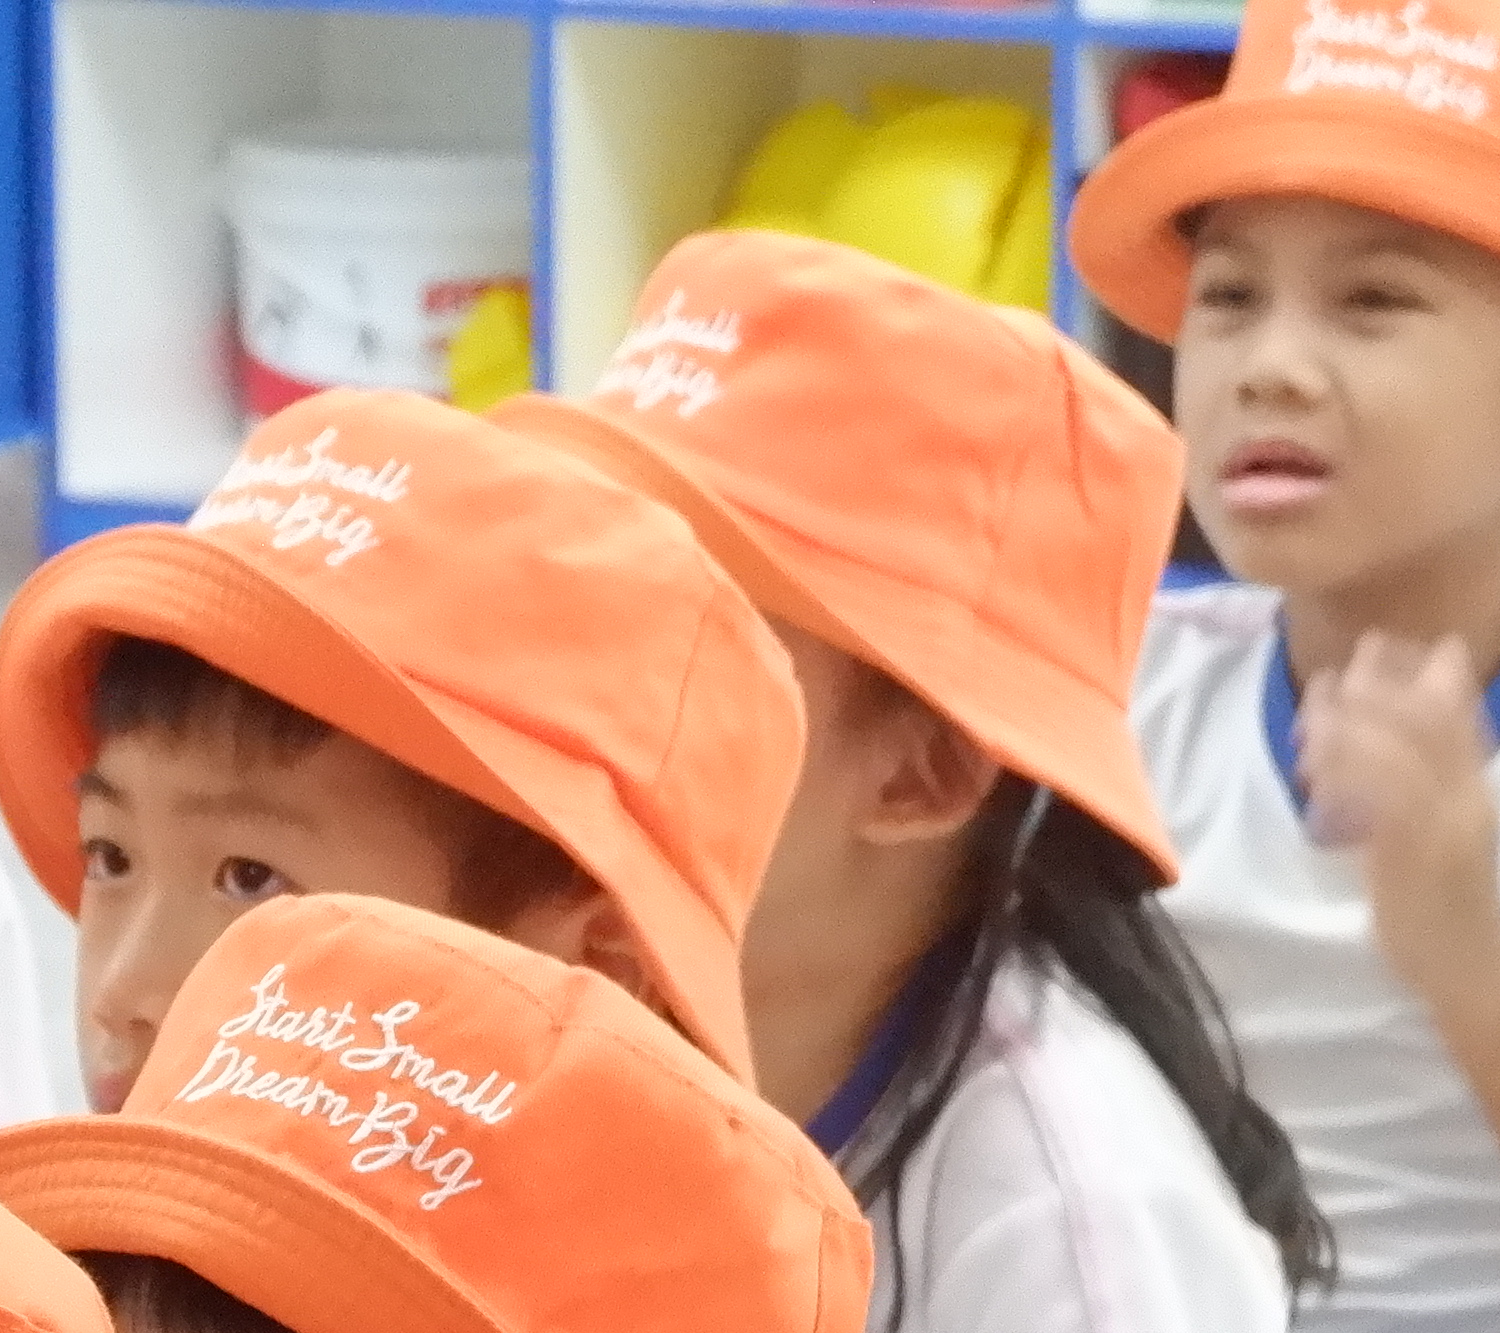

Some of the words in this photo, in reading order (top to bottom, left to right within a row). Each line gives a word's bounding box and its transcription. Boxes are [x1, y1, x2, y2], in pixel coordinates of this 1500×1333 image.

[272, 493, 380, 566] Big
[174, 1039, 362, 1127] Dream
[348, 1091, 483, 1211] Big
[218, 963, 357, 1051] Start
[340, 1000, 517, 1125] Small
